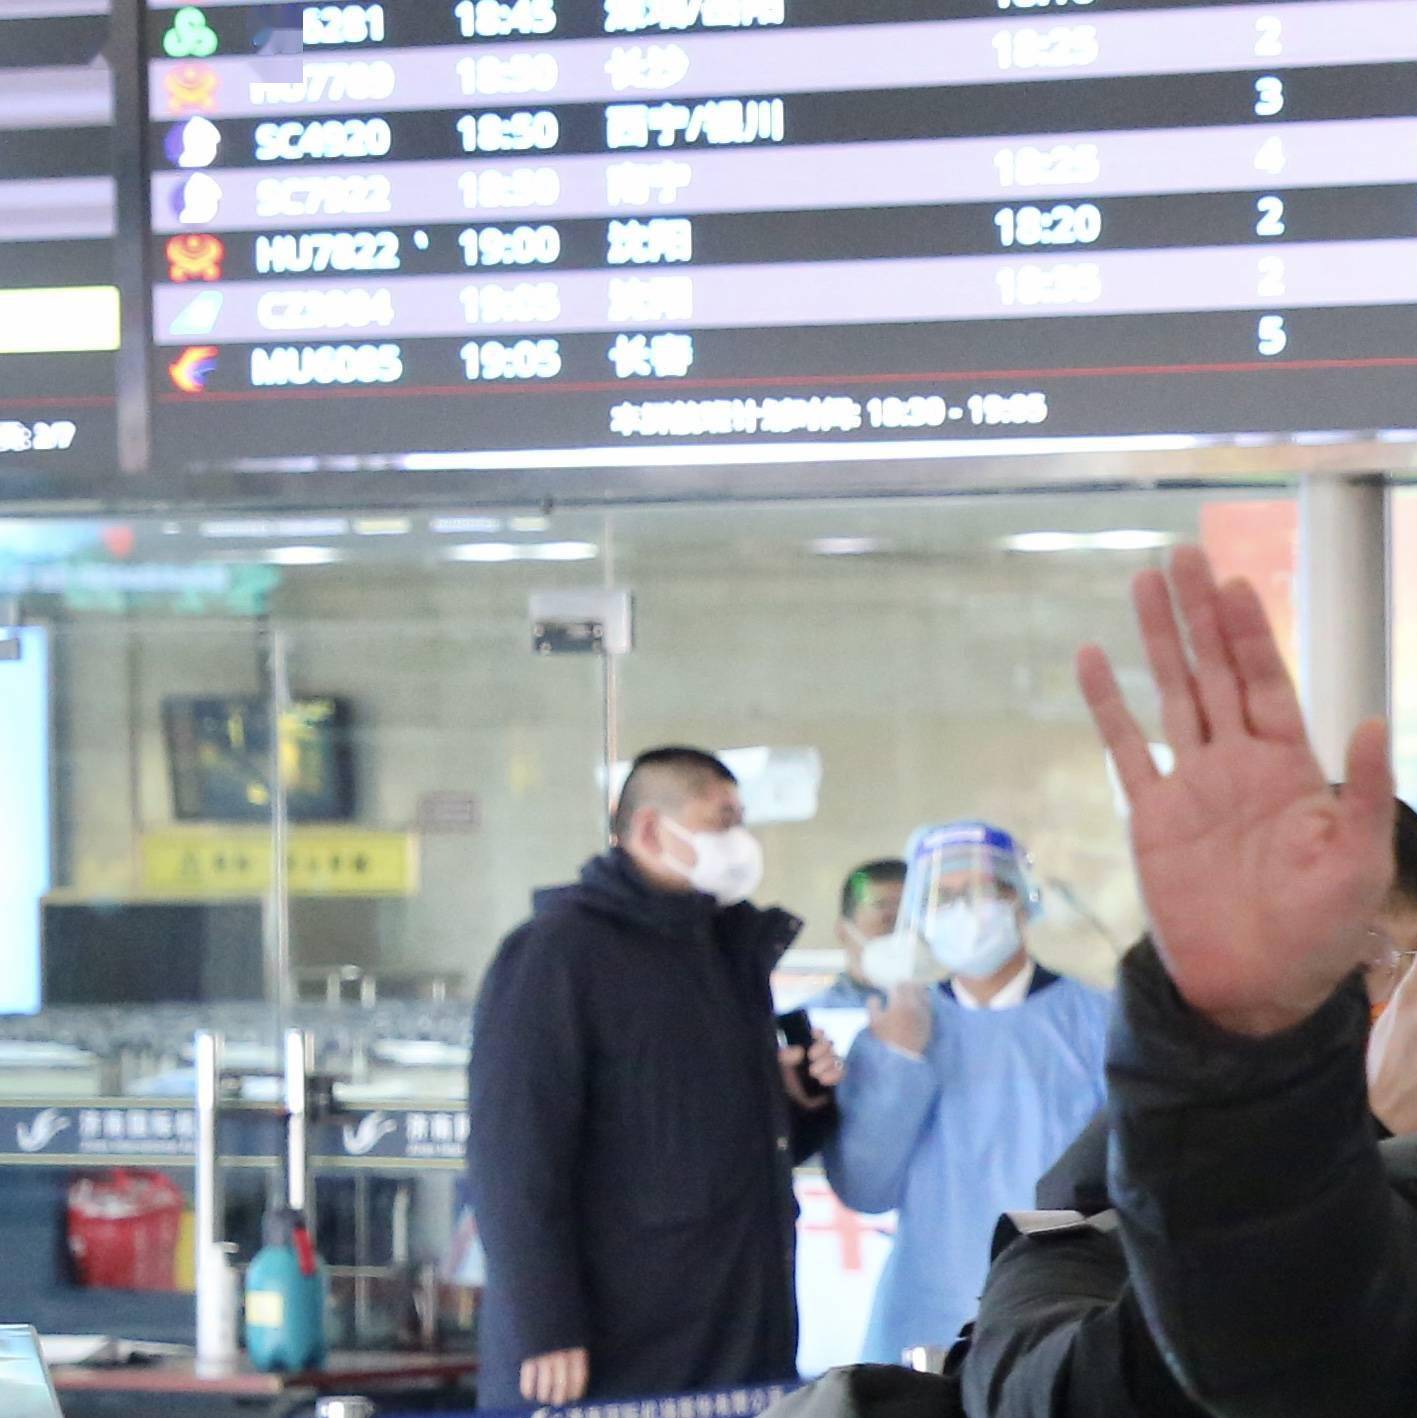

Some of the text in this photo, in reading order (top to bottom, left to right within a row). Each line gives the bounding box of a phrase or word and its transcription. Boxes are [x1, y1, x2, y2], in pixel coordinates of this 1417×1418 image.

[1255, 18, 1281, 55] 2
[1256, 78, 1283, 115] 3
[1254, 137, 1286, 175] 4
[459, 226, 560, 265] 19:00
[995, 205, 1101, 245] 18:20
[1257, 197, 1284, 235] 2
[1258, 257, 1285, 296] 2
[461, 340, 561, 379] 19:05
[1259, 316, 1286, 354] 5
